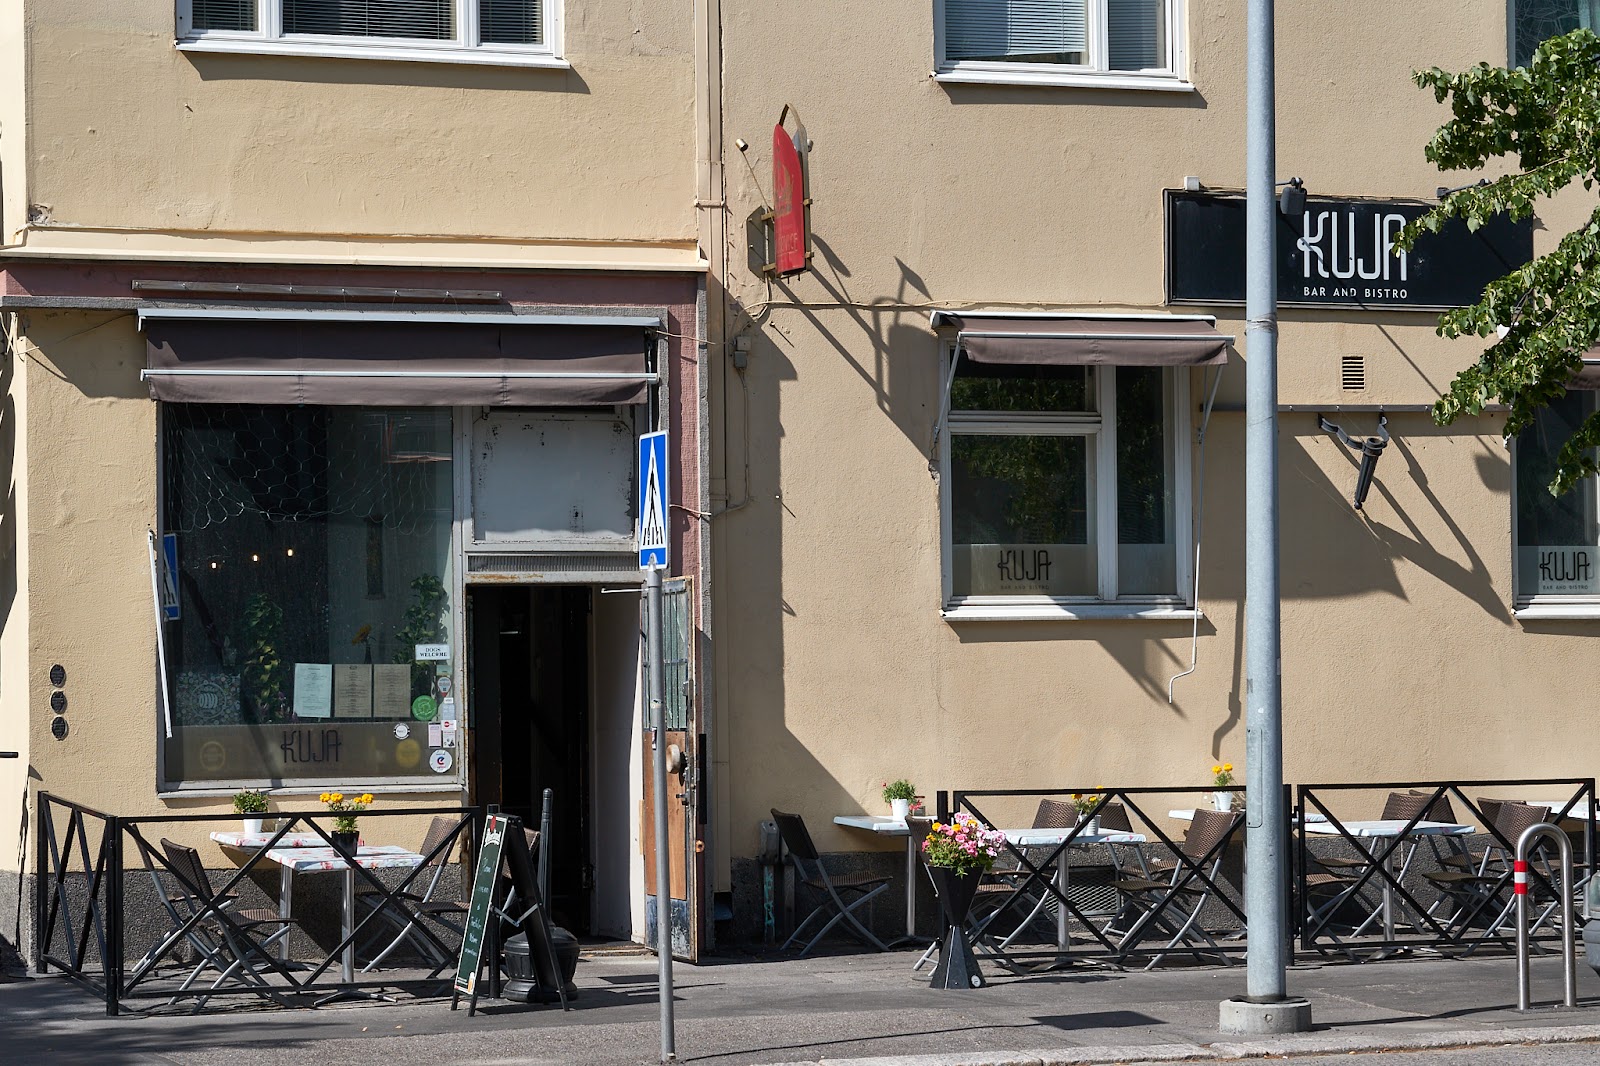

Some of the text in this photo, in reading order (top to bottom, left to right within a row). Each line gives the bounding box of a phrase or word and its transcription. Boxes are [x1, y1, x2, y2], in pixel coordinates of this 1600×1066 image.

[1296, 210, 1408, 282] KUJA
[1303, 286, 1408, 299] BAR AND BISTRO
[997, 549, 1052, 581] KUJA
[1539, 551, 1591, 581] KUJA
[280, 729, 342, 764] KUJA
